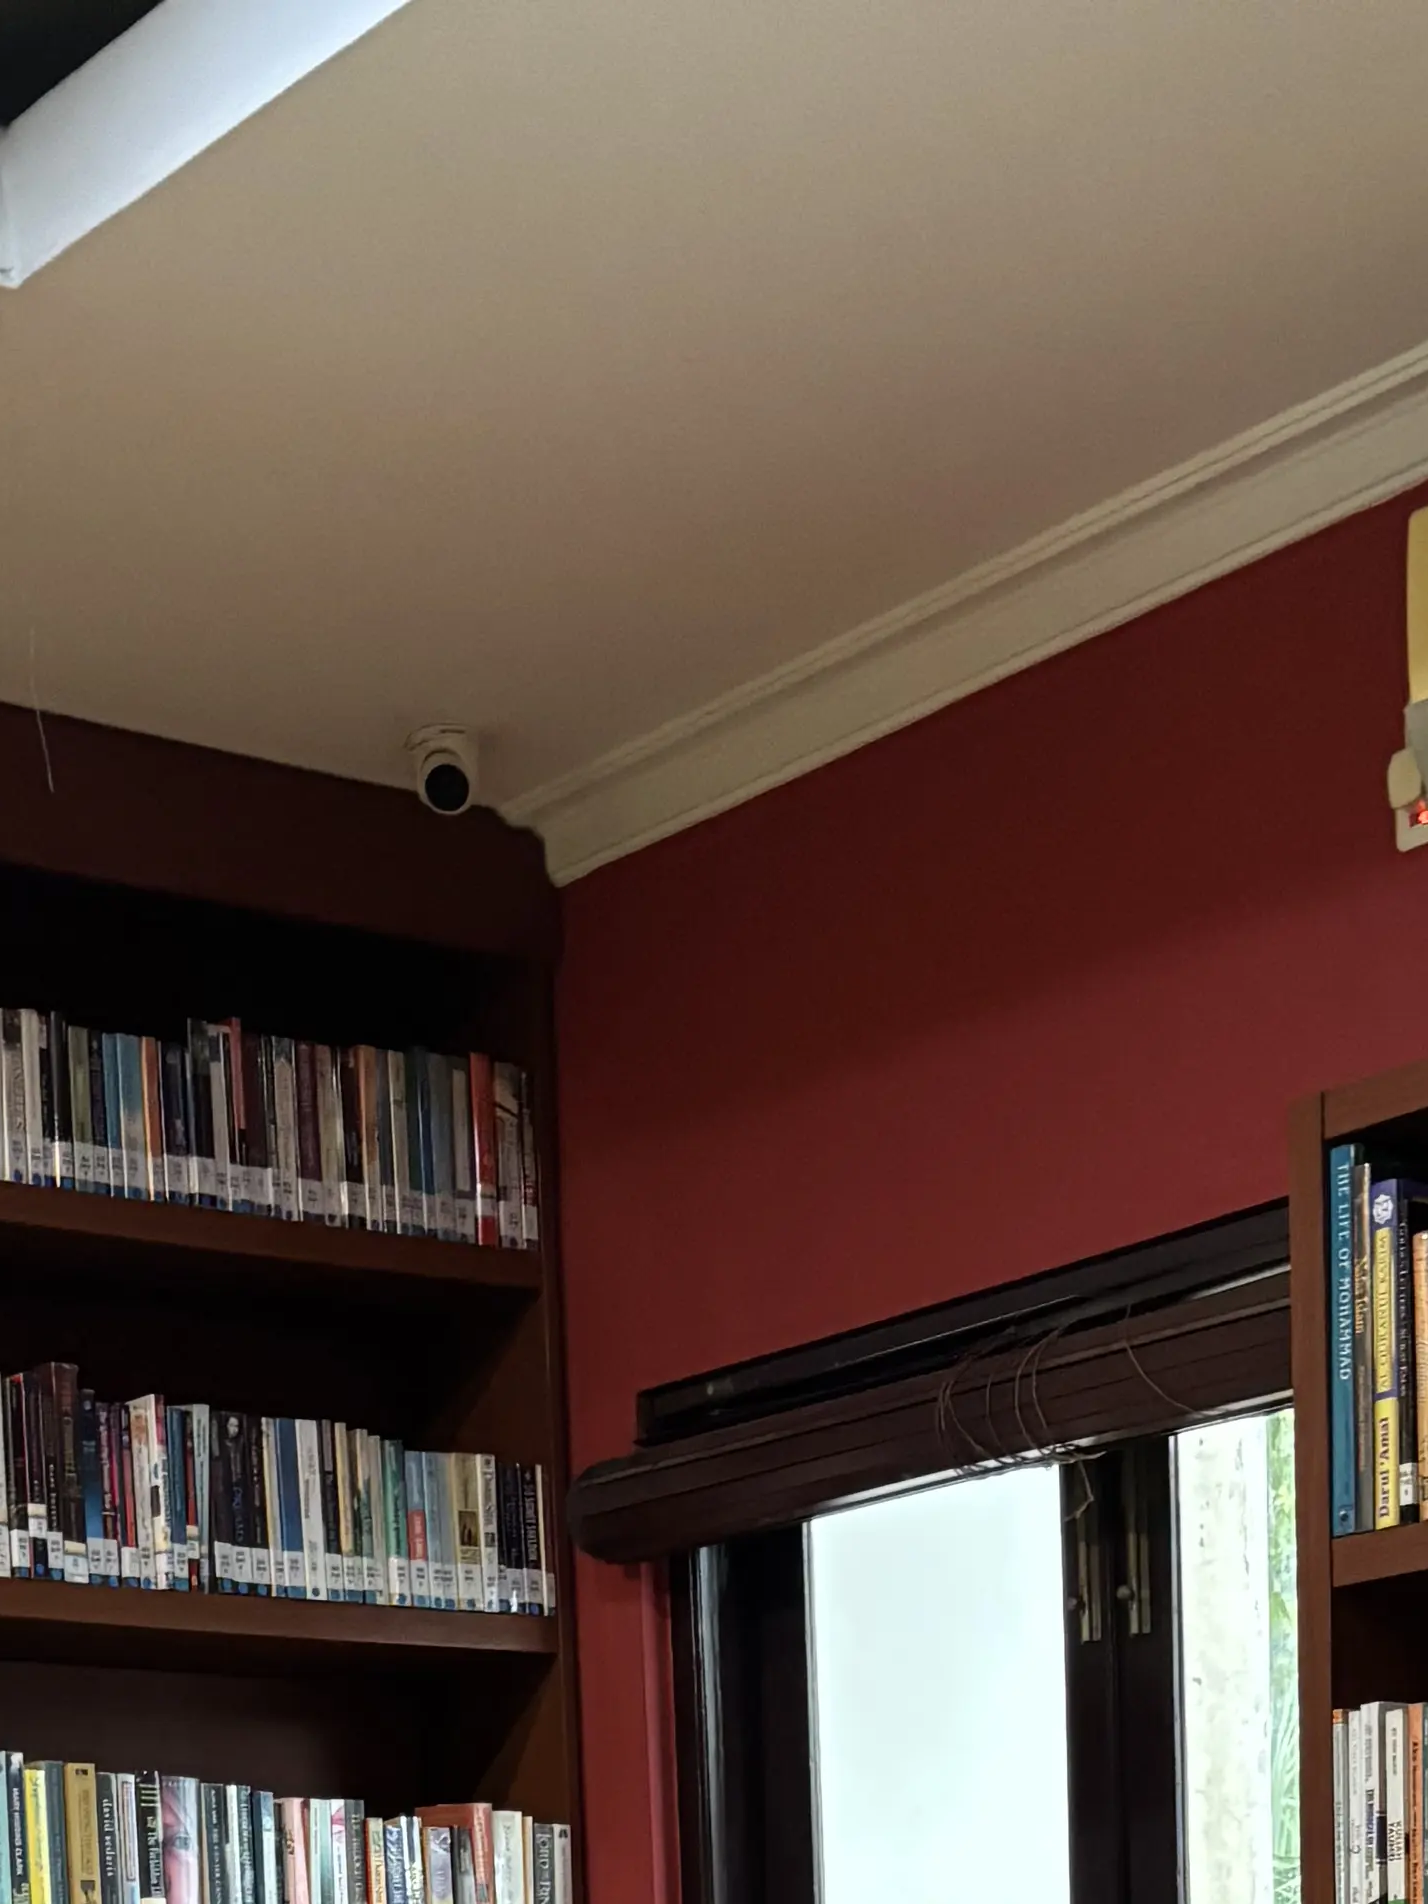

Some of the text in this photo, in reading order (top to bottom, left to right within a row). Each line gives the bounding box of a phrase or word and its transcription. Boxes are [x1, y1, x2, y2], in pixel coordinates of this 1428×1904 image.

[1337, 1164, 1352, 1381] THE LIFE OF MOHAMMAD
[13, 1848, 24, 1876] CLARK
[102, 1798, 116, 1877] david sedaris
